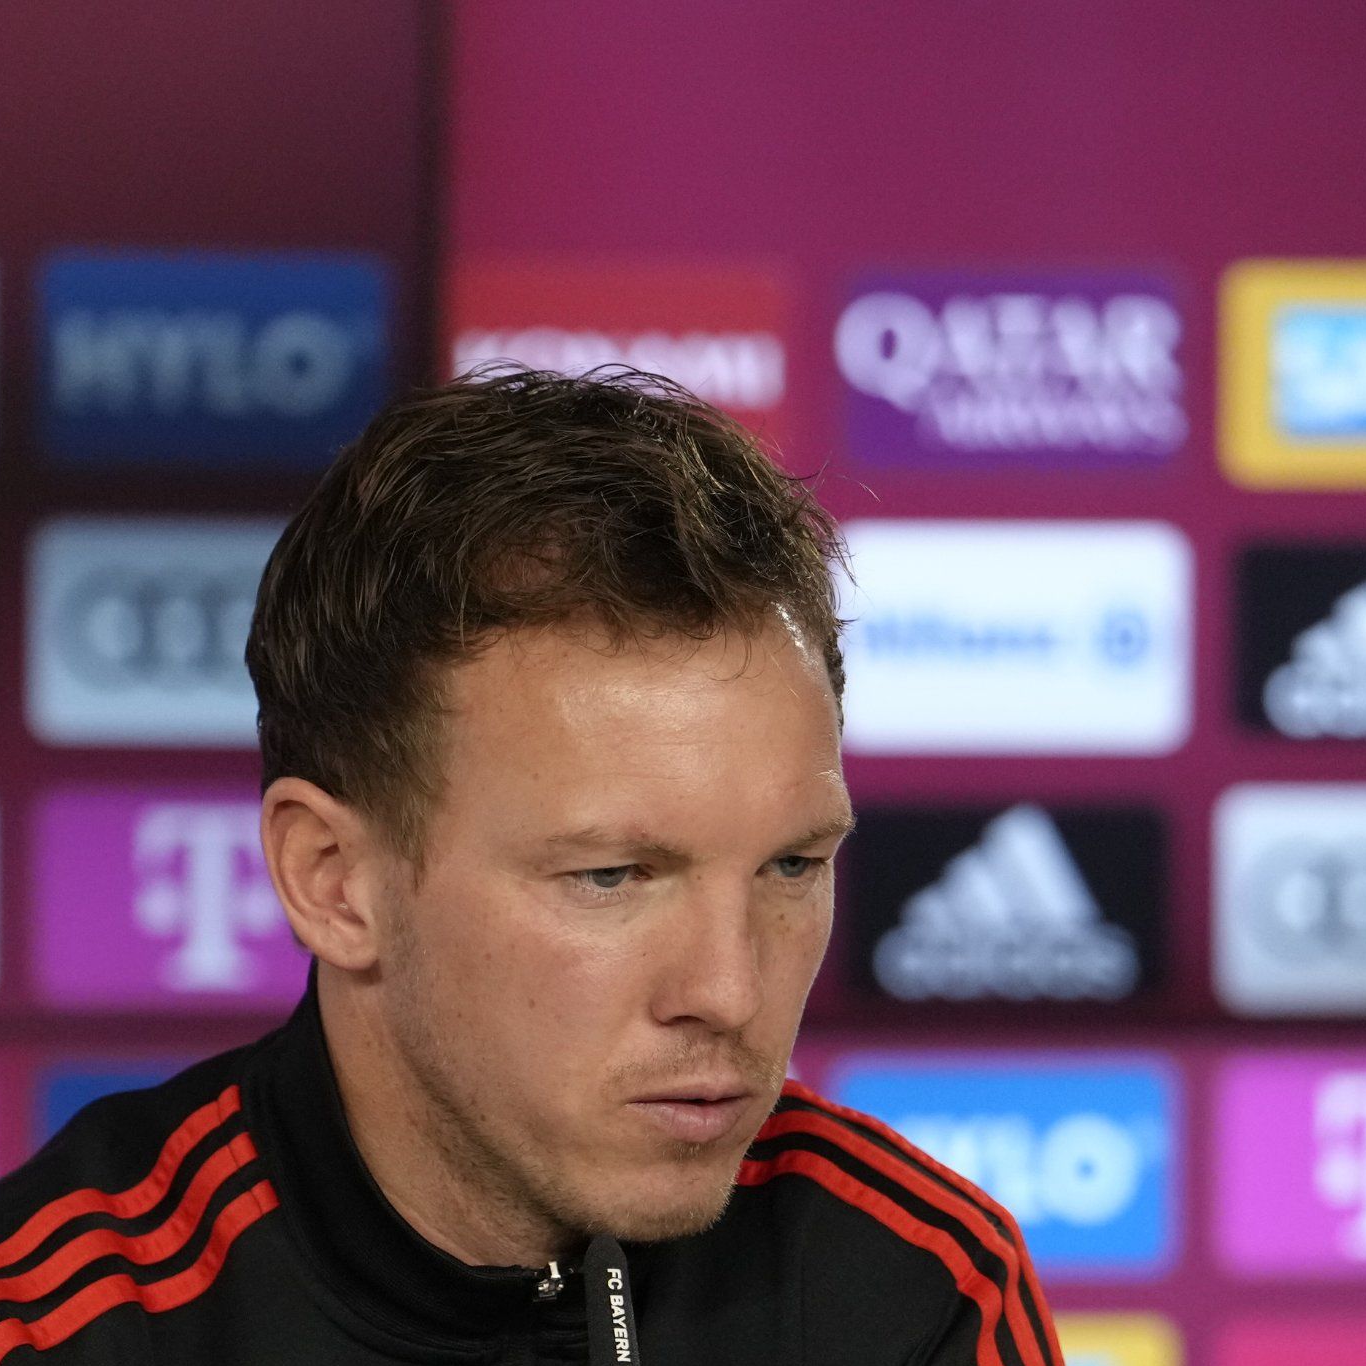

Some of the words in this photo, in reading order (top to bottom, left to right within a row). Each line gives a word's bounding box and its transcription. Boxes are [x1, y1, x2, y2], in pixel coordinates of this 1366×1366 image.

[55, 311, 351, 416] HYLO
[836, 292, 1183, 408] QATAR
[874, 924, 1140, 999] adidas
[607, 1267, 623, 1290] FC
[610, 1294, 631, 1363] BAYERN
